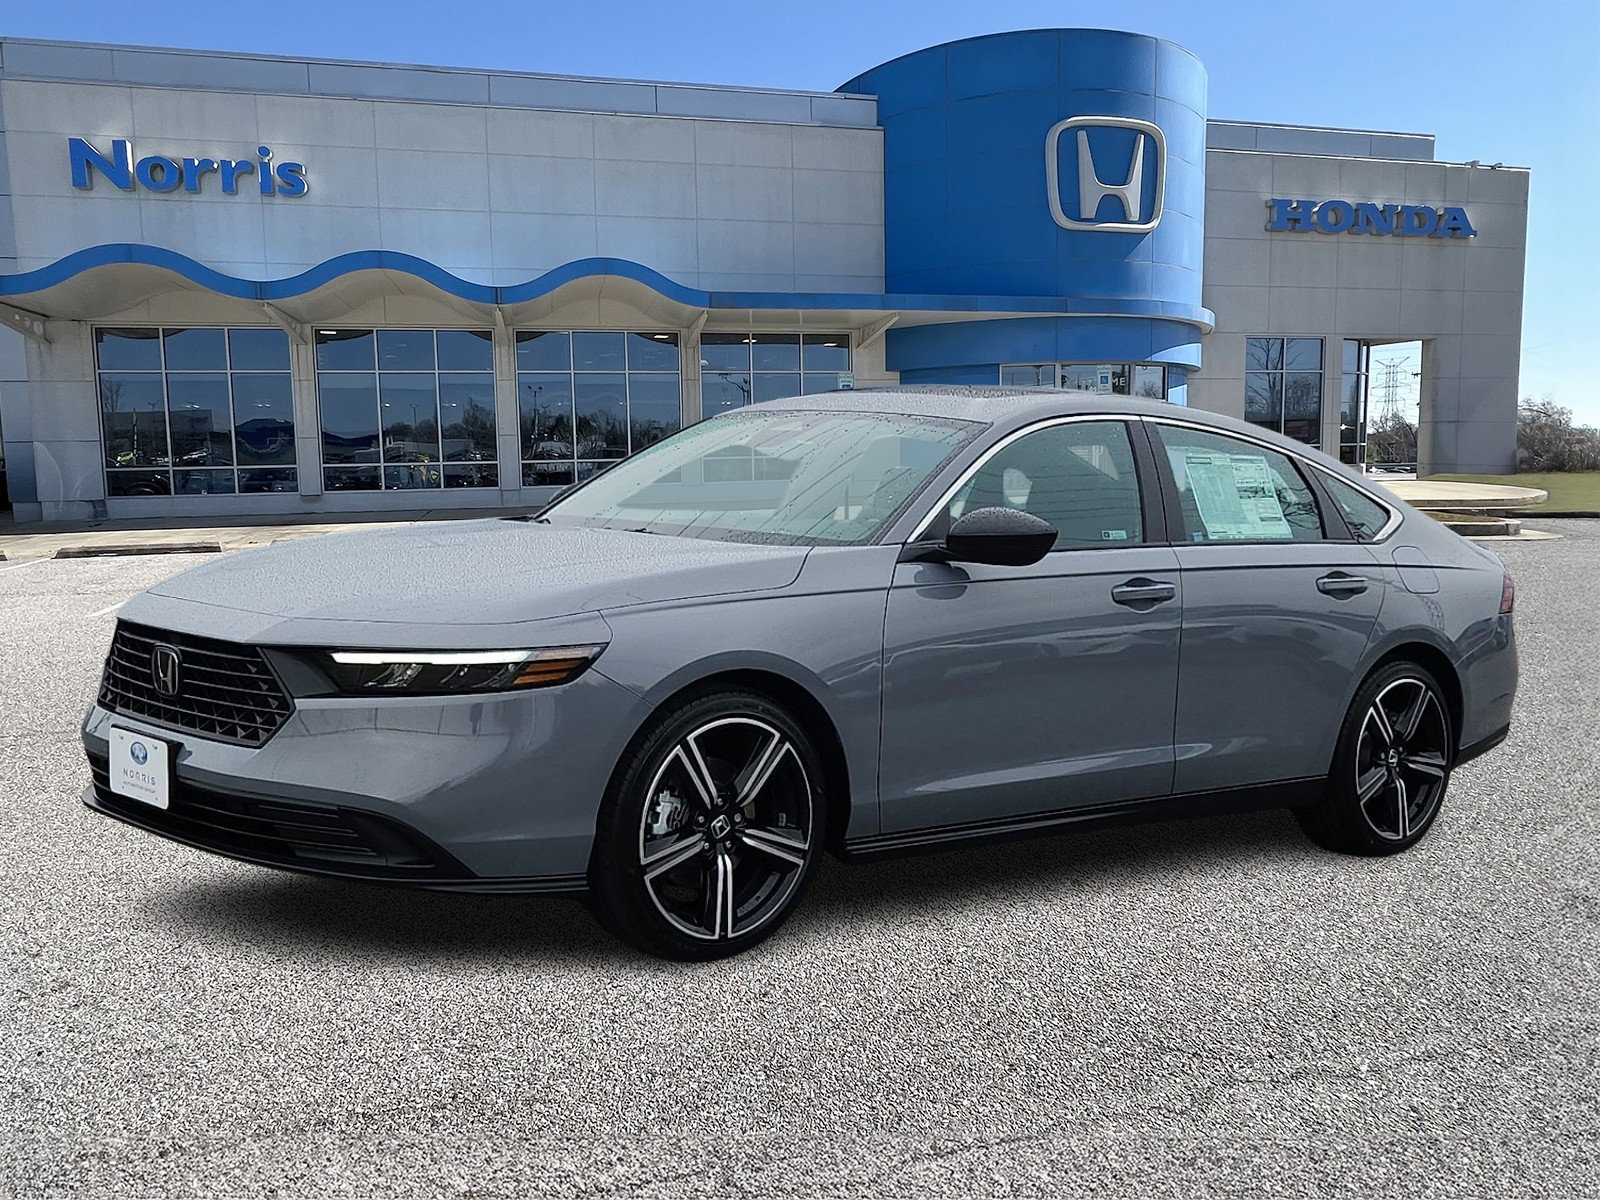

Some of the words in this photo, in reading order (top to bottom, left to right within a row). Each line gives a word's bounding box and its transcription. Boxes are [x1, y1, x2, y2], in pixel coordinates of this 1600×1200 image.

[68, 138, 309, 197] Norris
[1265, 198, 1478, 239] HONDA
[123, 767, 156, 785] NORRIS
